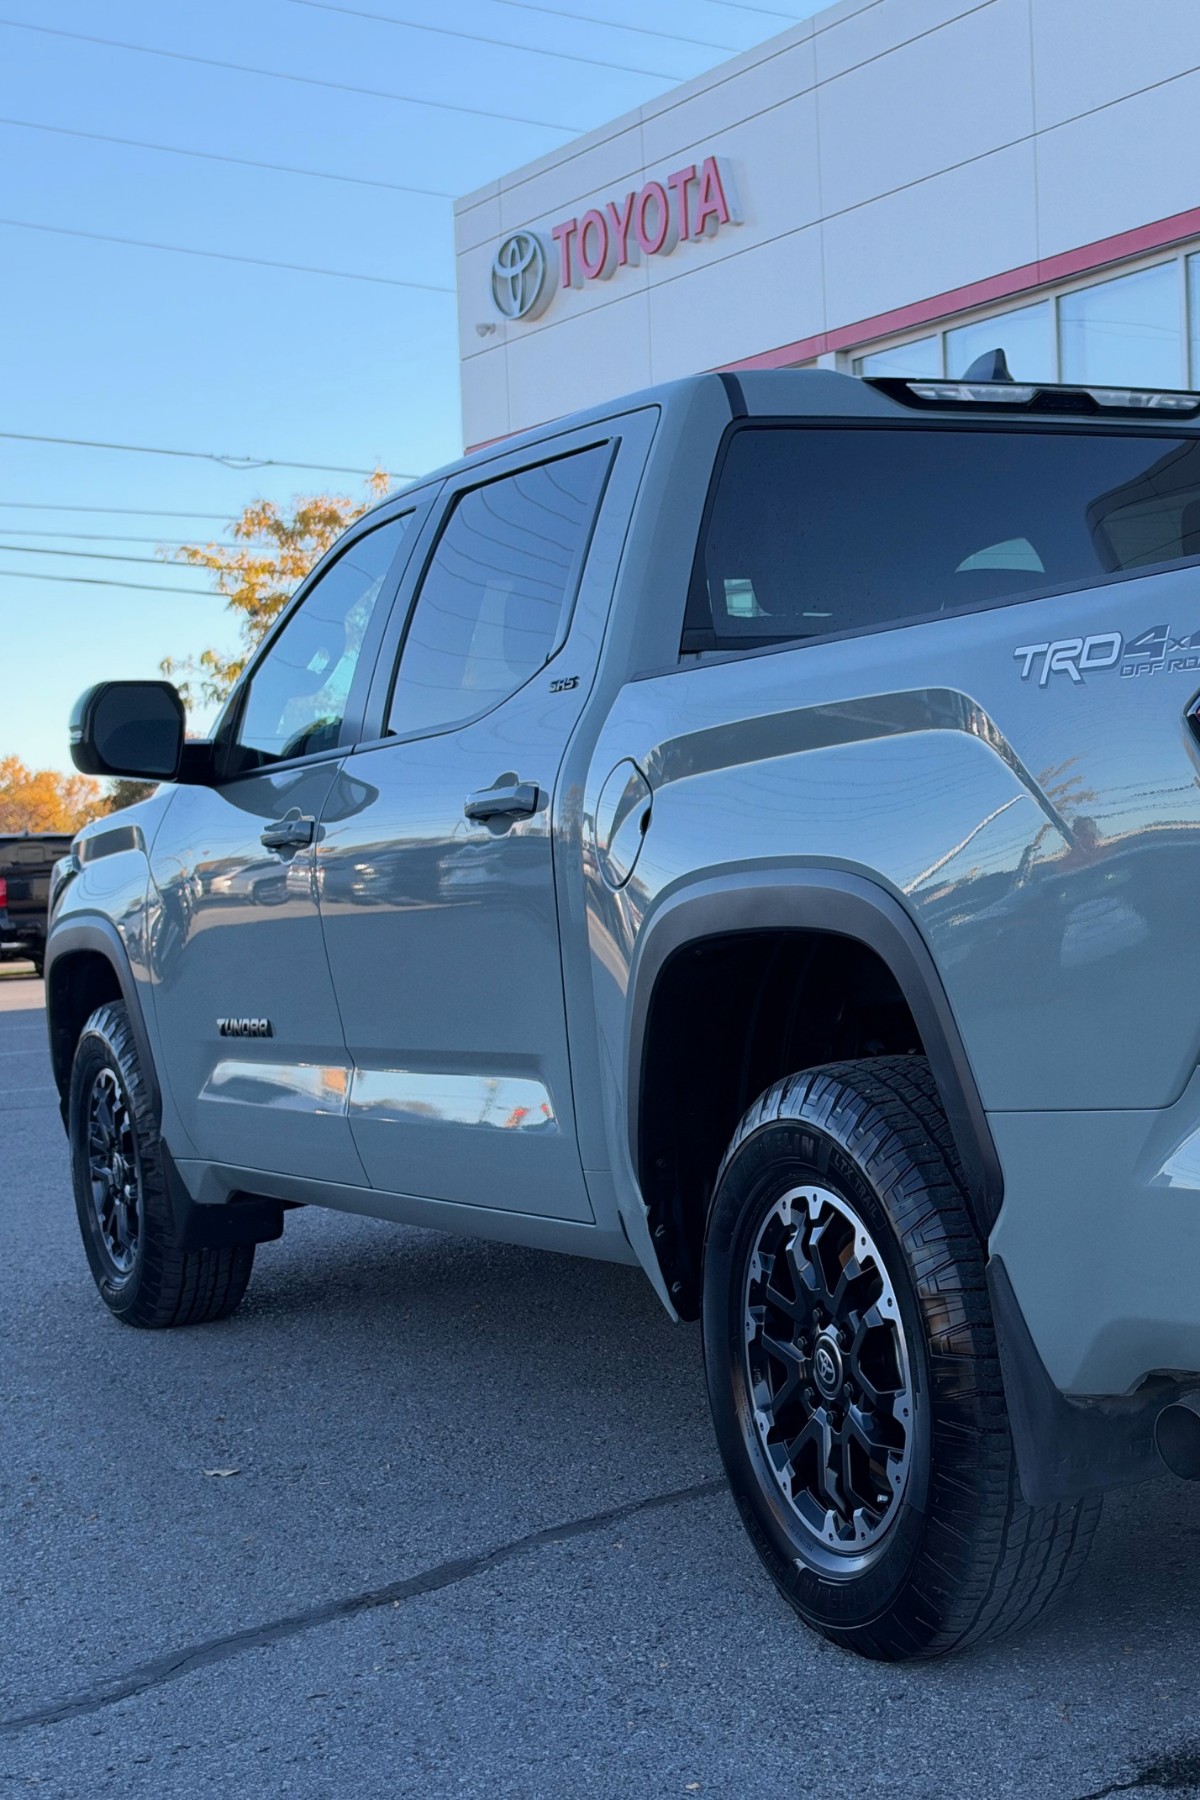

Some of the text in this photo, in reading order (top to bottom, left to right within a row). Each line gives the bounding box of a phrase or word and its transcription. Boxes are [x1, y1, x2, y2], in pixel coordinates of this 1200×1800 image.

[552, 155, 731, 289] TOYOTA
[1013, 631, 1124, 689] TRD
[1119, 661, 1164, 679] OFF
[216, 1018, 273, 1038] TUNDRA
[832, 1152, 879, 1219] LTX TRAIL
